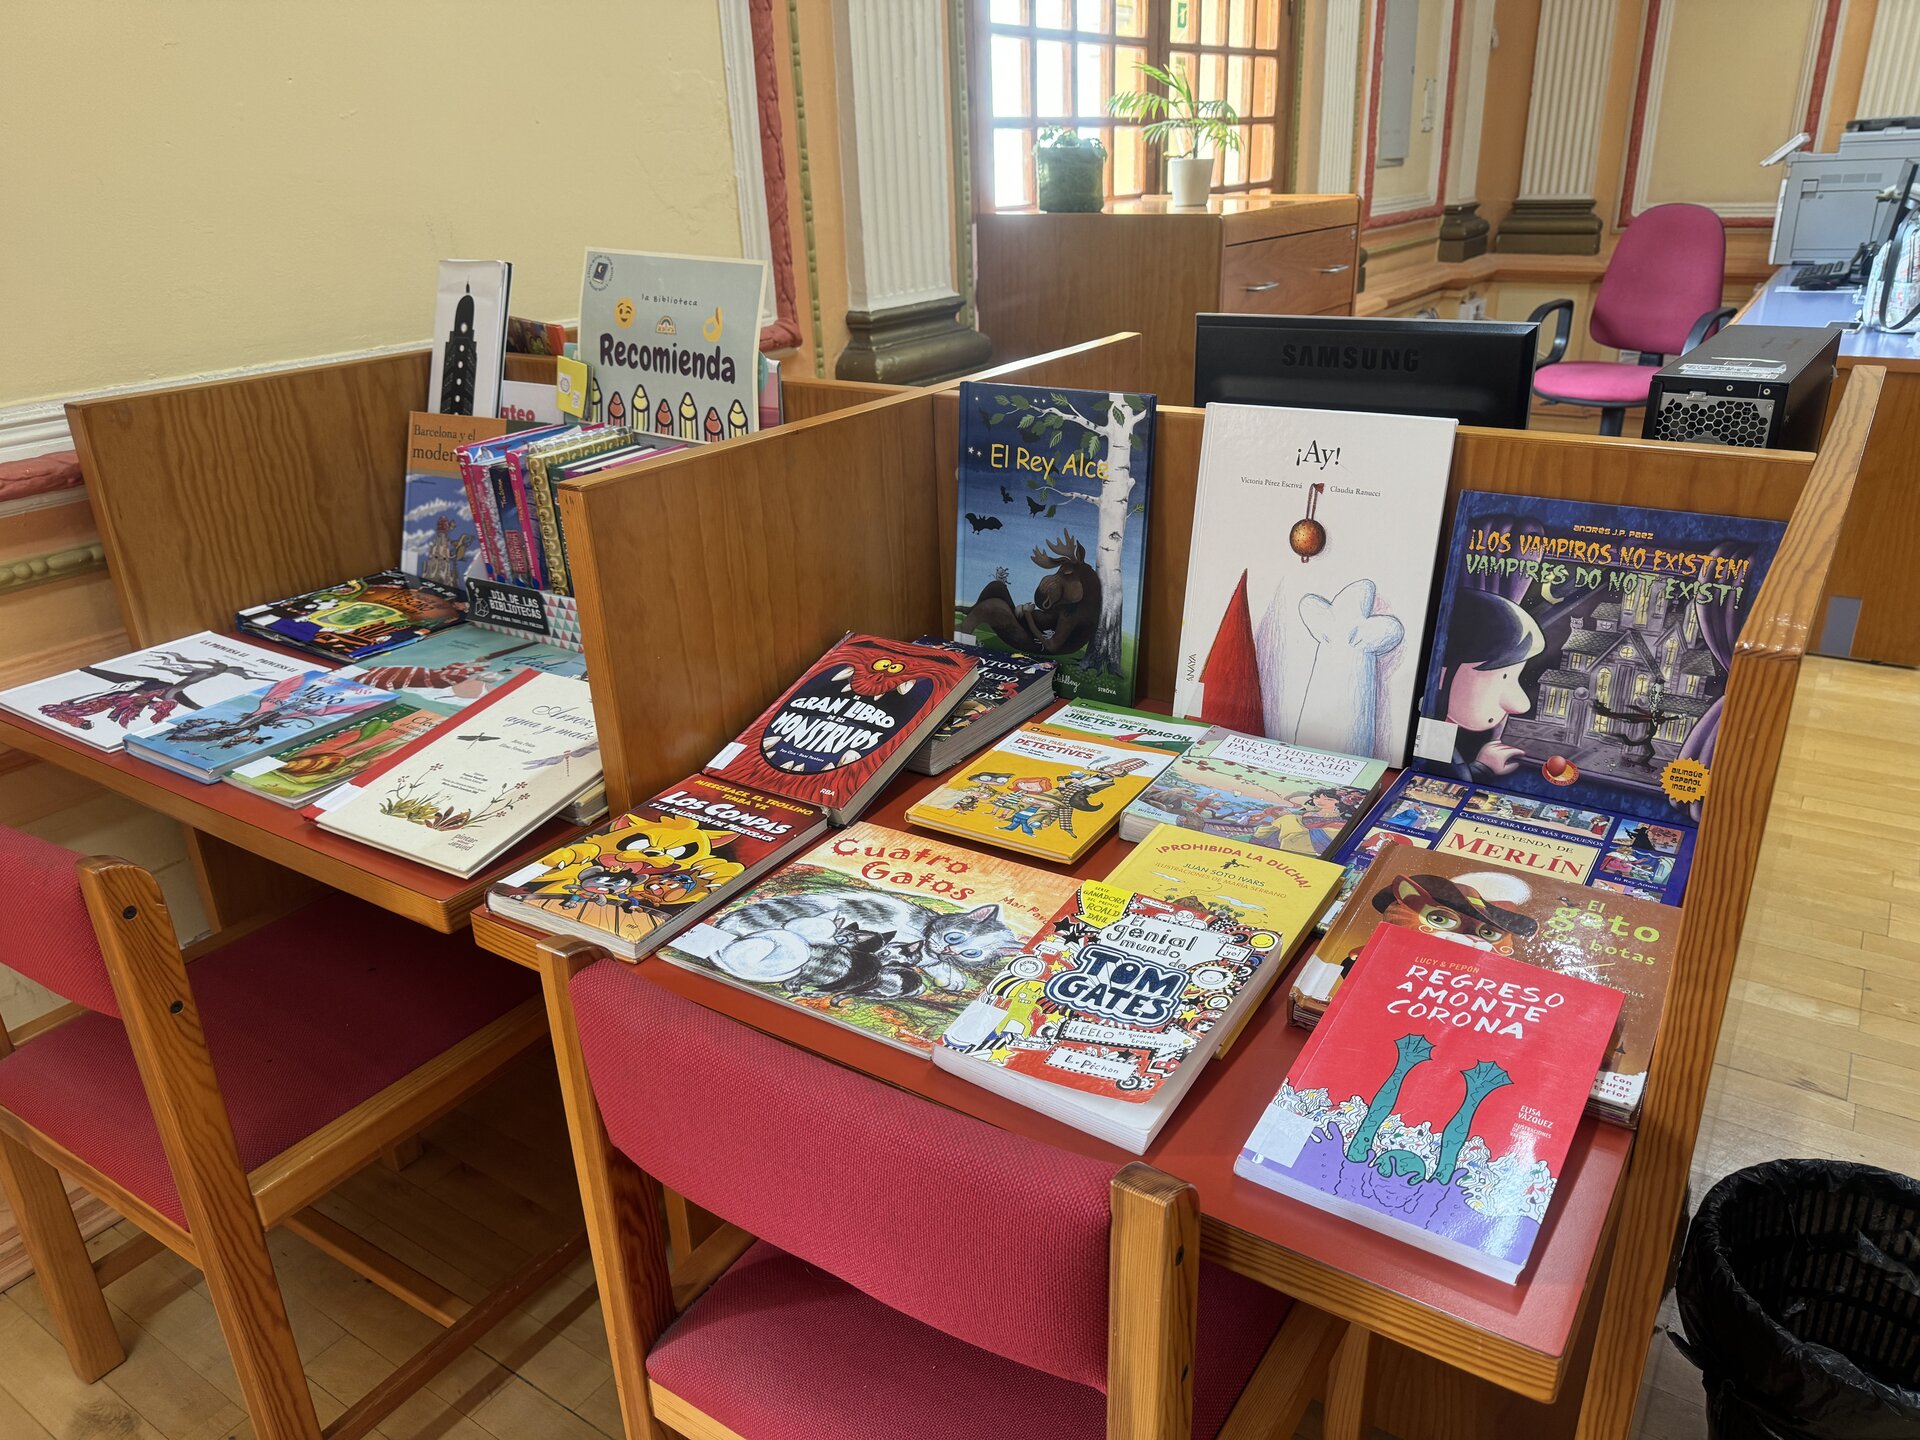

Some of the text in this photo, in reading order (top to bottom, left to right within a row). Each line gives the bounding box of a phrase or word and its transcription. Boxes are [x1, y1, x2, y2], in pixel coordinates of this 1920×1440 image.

[600, 333, 735, 384] Recomienda
[1282, 344, 1420, 372] SAMSUNG
[500, 404, 535, 421] ateo
[414, 424, 476, 442] Barcelona y el
[990, 444, 1109, 480] El Rey Alce
[1295, 439, 1341, 471] ¡Ay!
[1240, 476, 1263, 486] Victoria
[1264, 478, 1280, 487] Pérez
[1330, 486, 1354, 494] Claudia
[1469, 529, 1750, 583] ¡LOS VAMPIROS NO EXISTEN!
[1466, 553, 1744, 610] VAMPIRES DO NOT EXIST!
[489, 600, 542, 620] BIBLIOTECAS
[508, 594, 538, 608] DE LAS
[790, 696, 894, 728] GRAN LIBRO
[1096, 713, 1114, 721] PARA
[770, 711, 883, 754] MONSTRUOS
[1118, 723, 1138, 732] DE
[1139, 727, 1192, 743] DRAGÓN
[1227, 742, 1354, 774] PARA DORMIR
[1232, 737, 1359, 768] BREVES HISTORIAS
[1224, 750, 1346, 778] AUTORES DEL MUNDO
[1670, 776, 1702, 786] ESPAÑOL
[722, 794, 752, 806] TIMBA
[820, 788, 835, 796] RBA
[670, 806, 714, 824] MALDICIÓN
[711, 818, 725, 827] DE
[766, 798, 814, 816] TROLLINO
[1458, 811, 1604, 847] CLÁSICOS PARA LOS MÁS PEQUEÑOS
[1473, 826, 1574, 854] LA LEYENDA DE
[831, 838, 970, 874] Cuatro
[1447, 832, 1586, 878] MERLÍN
[1156, 843, 1312, 889] ¡PROHIBIDA LA DUCHA!
[1182, 862, 1265, 887] JUAN SOTO IVARS
[862, 861, 975, 900] Gatos
[1154, 862, 1210, 880] ILUSTRACIONES
[1224, 879, 1250, 890] MARÍA
[1250, 885, 1287, 899] SERRANO
[998, 896, 1026, 908] Mar
[1084, 890, 1126, 906] GANADORA
[1588, 900, 1606, 913] El
[1086, 902, 1120, 917] ROALD
[1086, 912, 1108, 924] DAHL
[1130, 916, 1144, 927] El
[1548, 906, 1660, 942] gato
[1106, 924, 1199, 951] genial
[1120, 938, 1180, 958] mundo
[1590, 939, 1656, 965] botas
[1089, 949, 1182, 998] TOM
[1168, 960, 1188, 970] de
[1415, 956, 1480, 974] LUCY & PEPÓN
[1405, 964, 1565, 1008] REGRESO
[1058, 976, 1171, 1022] GATES
[1396, 981, 1548, 1022] A MONTE
[1386, 999, 1524, 1040] CORONA
[1068, 1024, 1114, 1039] ¡LÉELO
[1081, 1059, 1119, 1074] Pichon
[1594, 1078, 1630, 1093] xturas
[1612, 1075, 1632, 1086] Con
[1593, 1084, 1629, 1098] terior
[1518, 1111, 1554, 1128] VÁZQUEZ
[1520, 1105, 1542, 1118] ELISA
